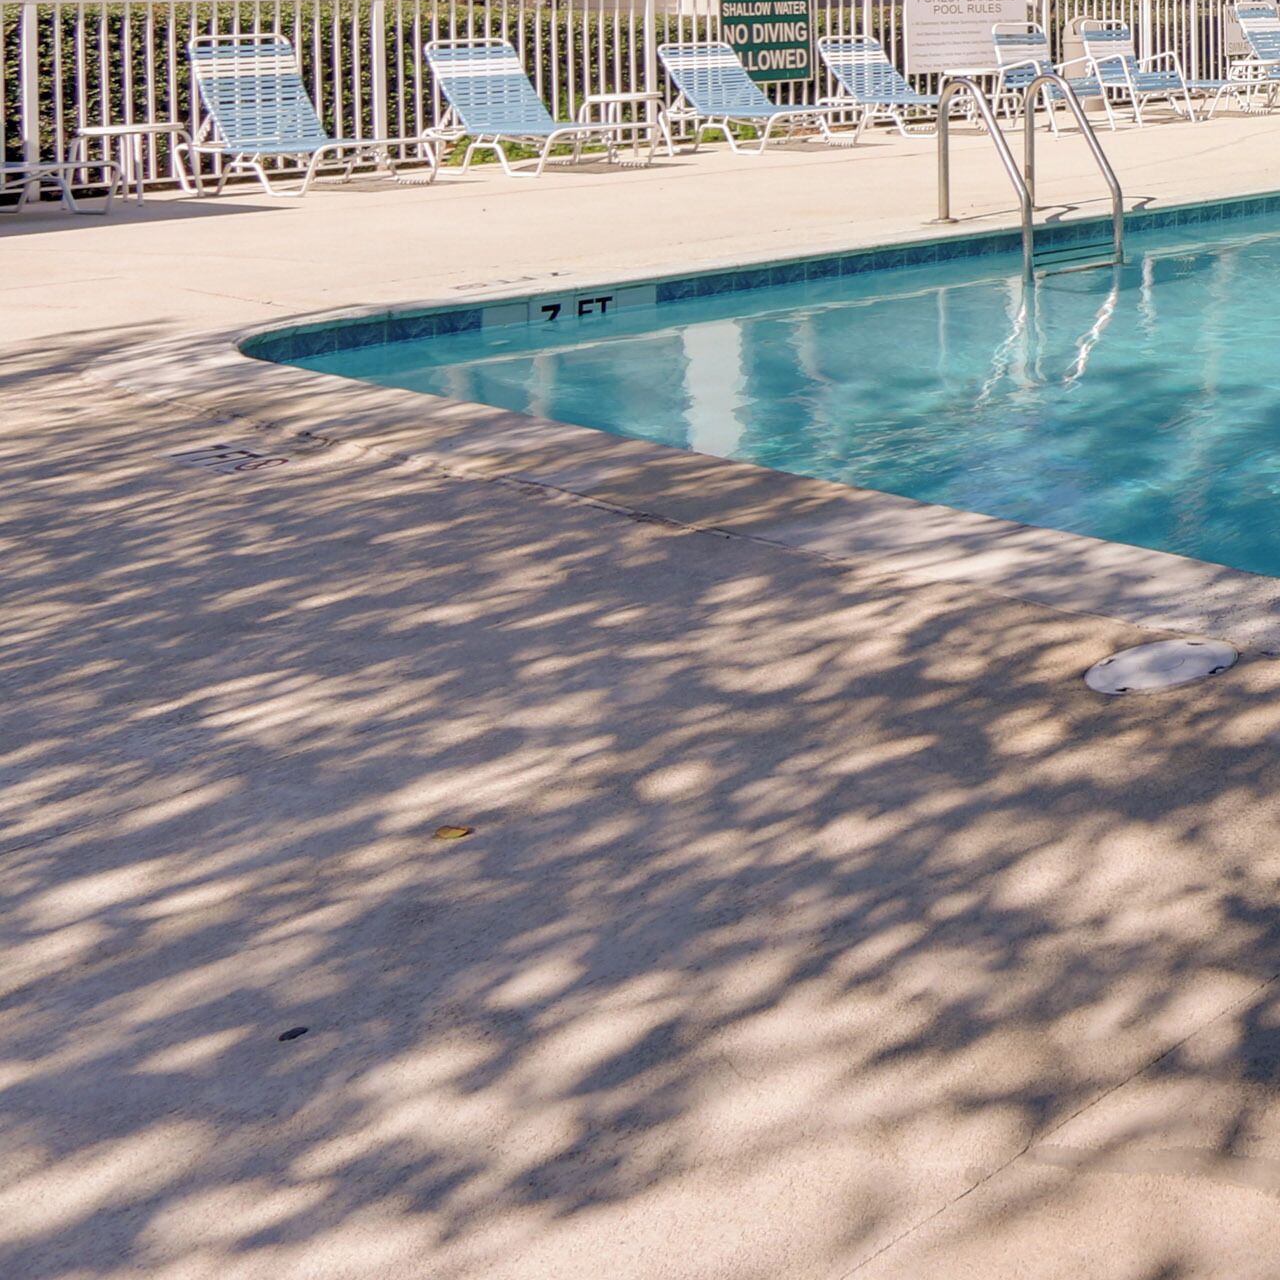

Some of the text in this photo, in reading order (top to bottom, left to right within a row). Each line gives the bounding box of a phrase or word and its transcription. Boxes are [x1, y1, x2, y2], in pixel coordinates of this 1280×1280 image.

[722, 1, 807, 17] SHALLOW WATER
[933, 3, 1002, 15] POOL RULES
[723, 21, 808, 45] NO DIVING
[737, 48, 808, 71] LLOWED
[541, 296, 613, 321] 7 FT
